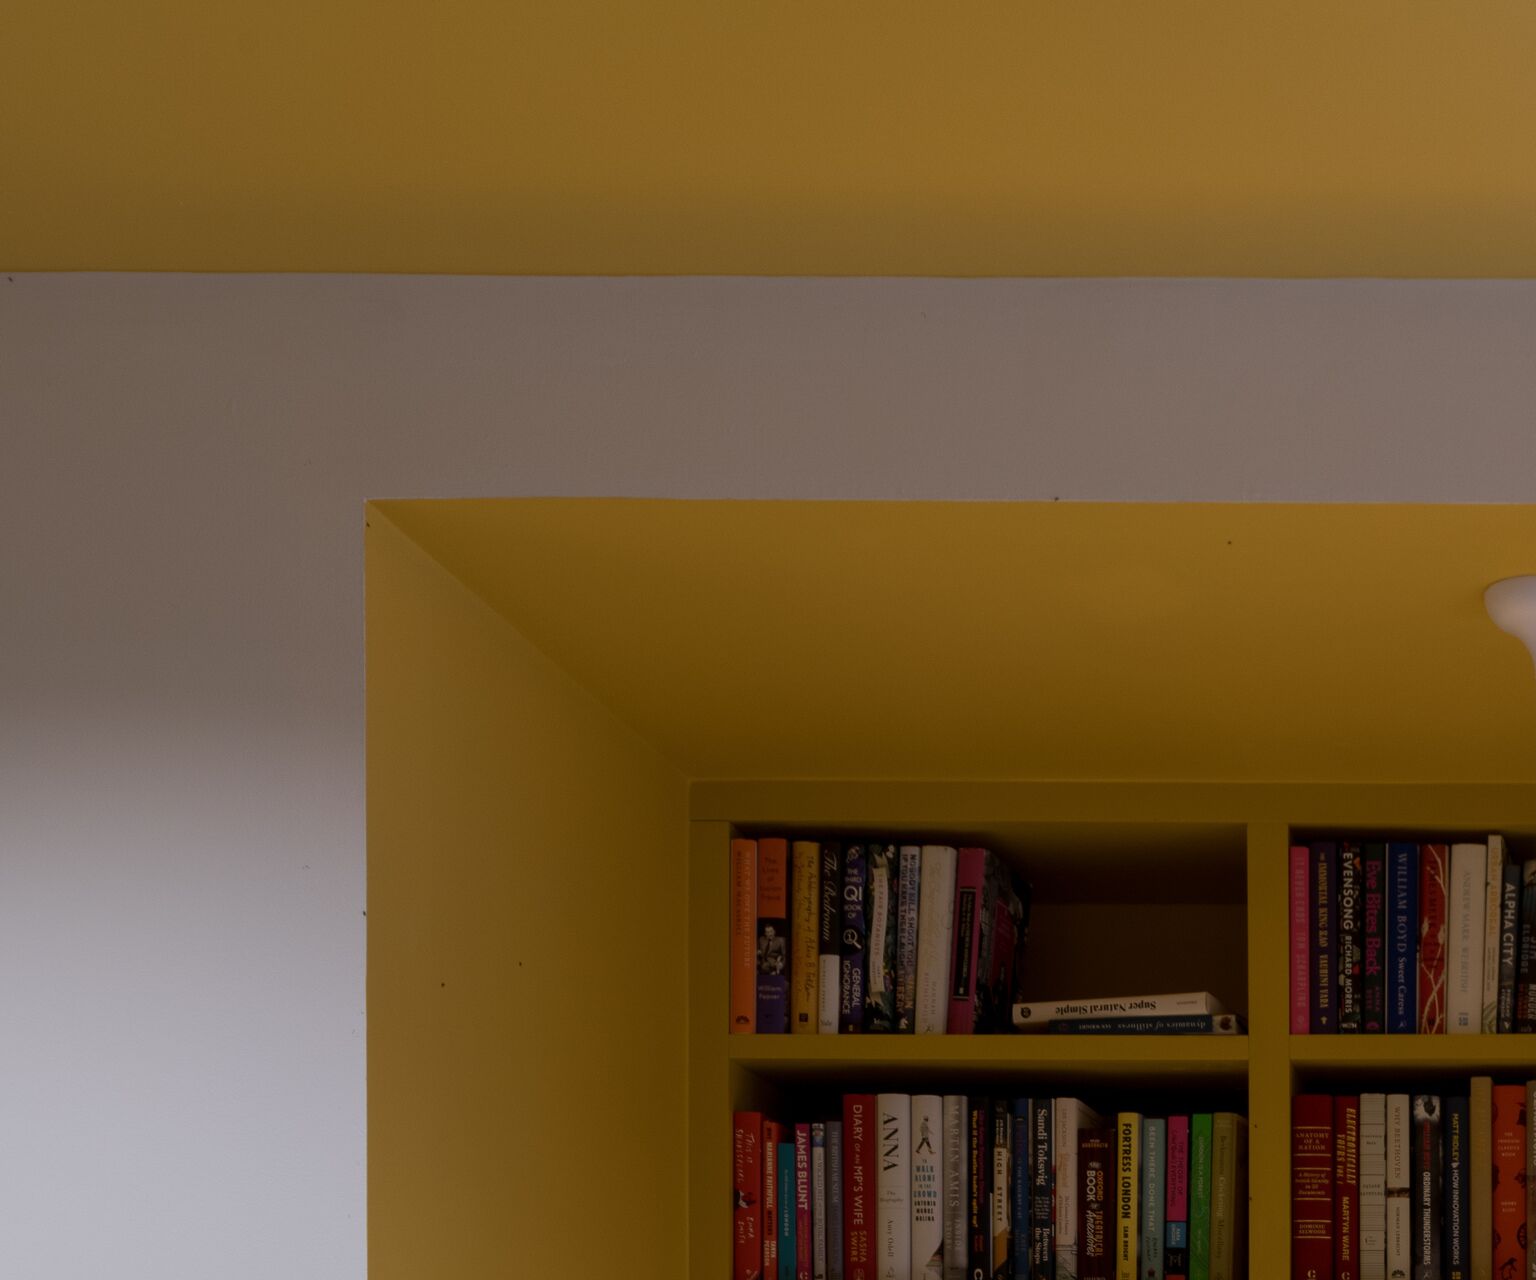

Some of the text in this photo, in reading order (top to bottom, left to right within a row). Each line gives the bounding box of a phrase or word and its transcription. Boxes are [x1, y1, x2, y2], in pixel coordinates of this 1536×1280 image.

[823, 850, 837, 943] The Bedroom
[1343, 852, 1354, 1014] EVENSONG RICHARD MORRIS
[1396, 853, 1408, 1015] WILLIAM BOYD Sweet Caress
[1502, 883, 1517, 966] ALPHA CITY
[842, 960, 852, 1014] IGNORANCE
[852, 968, 861, 1007] GENERAL
[853, 1105, 863, 1141] DIARY
[883, 1113, 898, 1172] ANNA
[1036, 1109, 1047, 1185] Sandi Toksvig
[797, 1130, 807, 1210] JAMES BLUNT
[1122, 1123, 1132, 1219] FORTRESS LONDON
[1423, 1172, 1431, 1206] ORDINARY
[853, 1195, 862, 1224] WIFE
